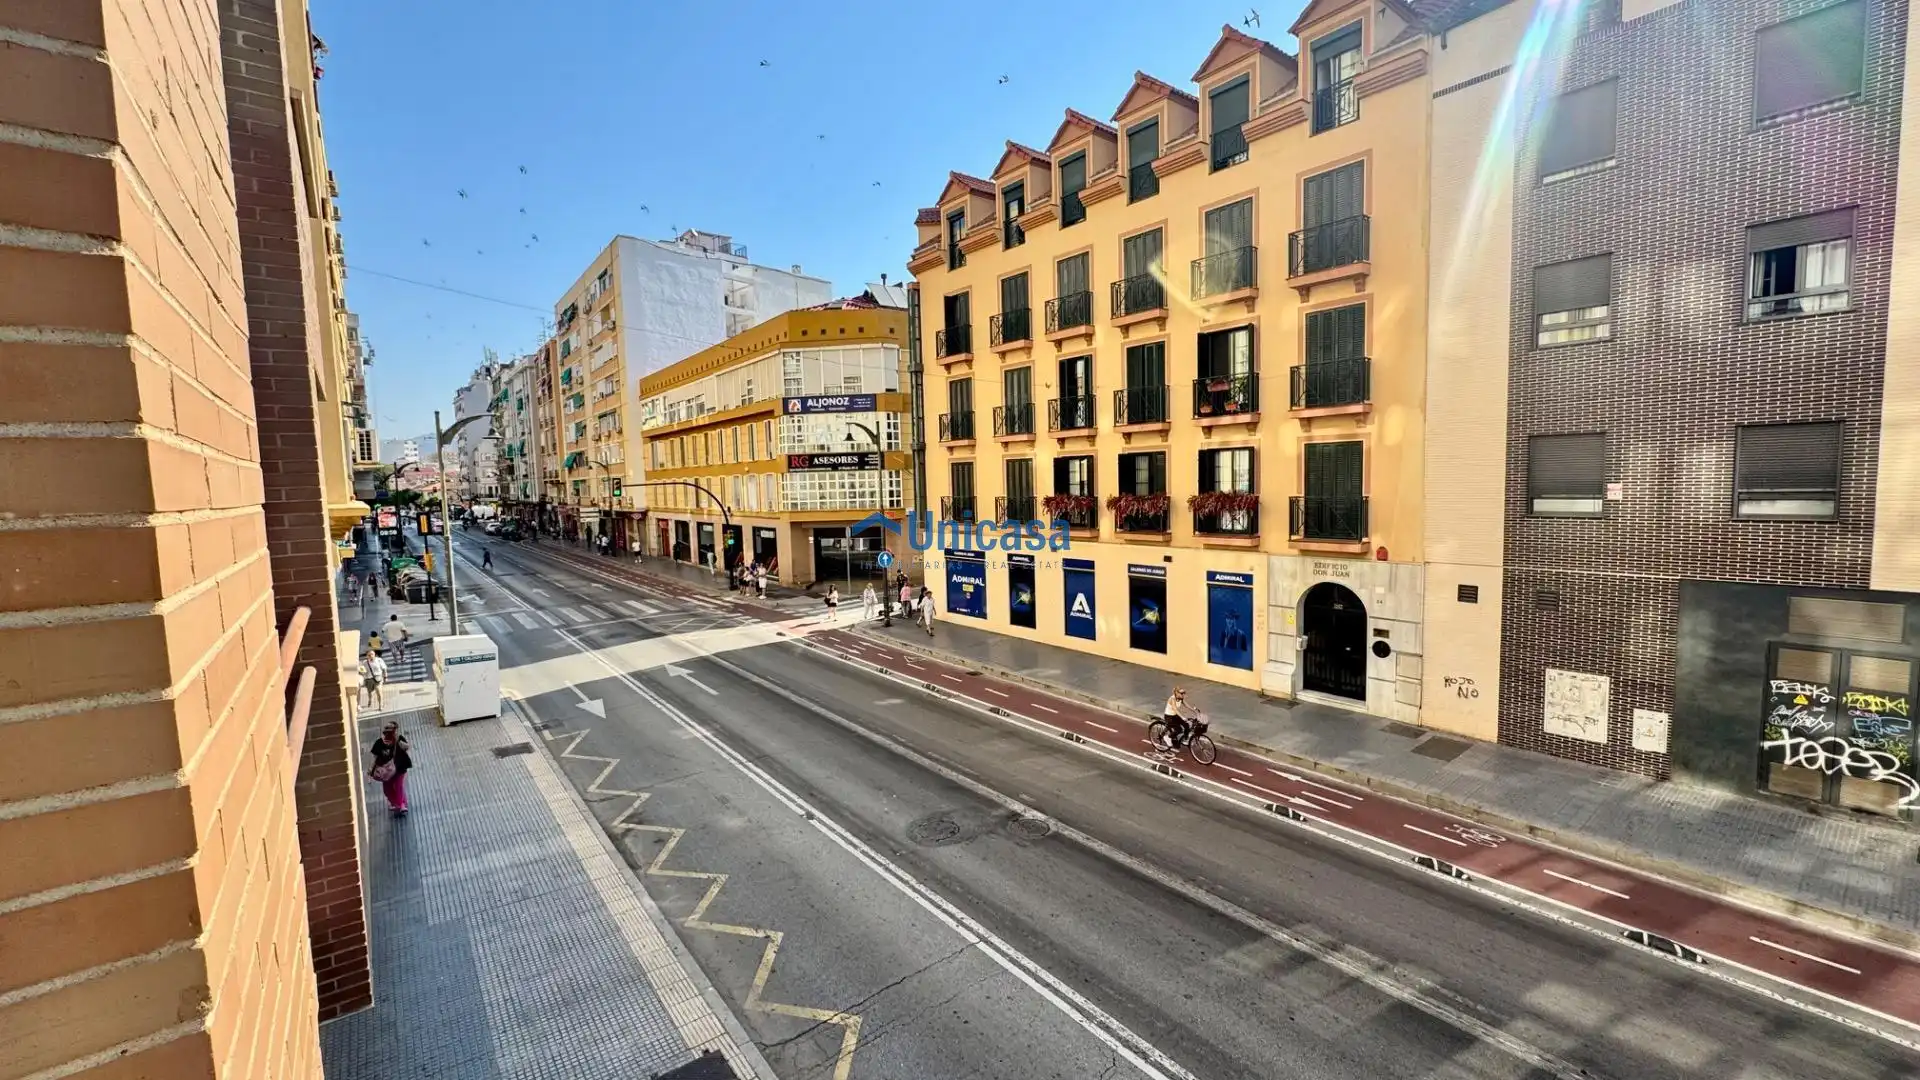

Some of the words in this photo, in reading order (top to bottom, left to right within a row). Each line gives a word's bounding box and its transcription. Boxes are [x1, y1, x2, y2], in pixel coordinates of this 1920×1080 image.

[807, 397, 849, 407] ALJONOZ
[791, 455, 809, 468] RG
[813, 456, 858, 464] ASESORES
[1313, 561, 1349, 571] EDIFICIO
[1215, 573, 1245, 583] ADMIRAL
[1313, 569, 1329, 577] DON
[1331, 570, 1350, 578] JUAN
[952, 574, 985, 587] ADMIRAL
[1069, 611, 1093, 620] ADMIRAL
[1457, 685, 1479, 699] NO
